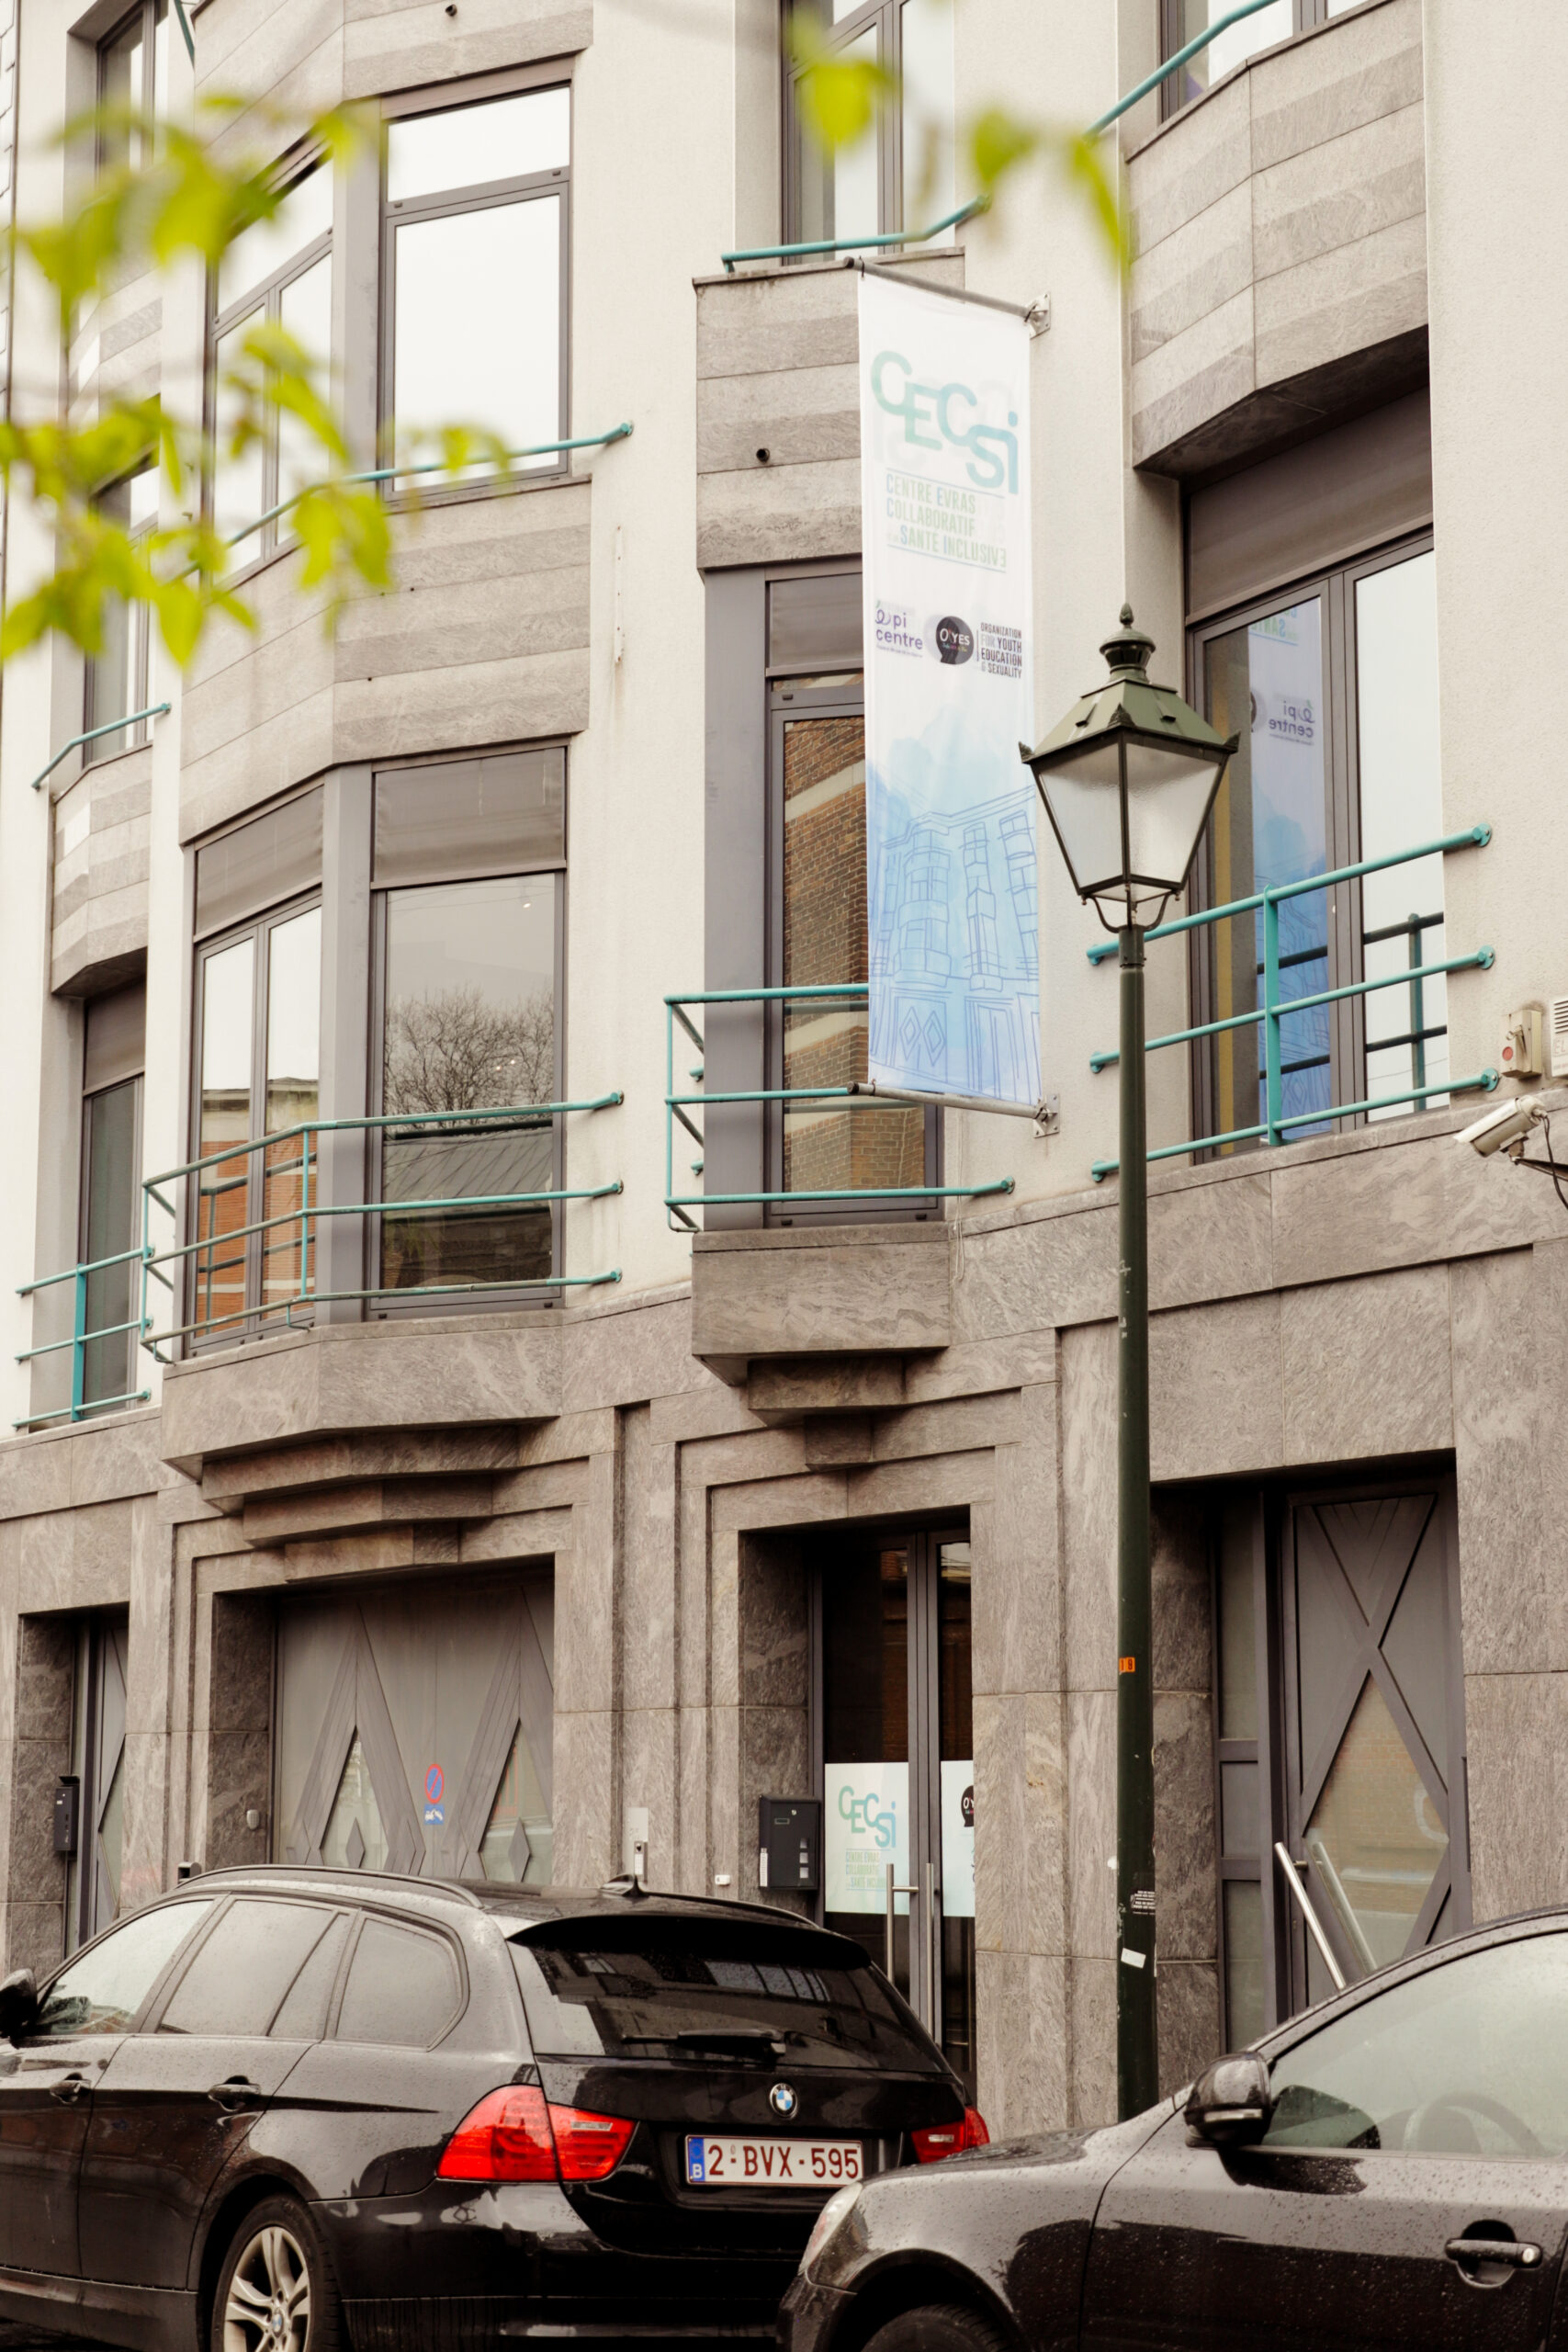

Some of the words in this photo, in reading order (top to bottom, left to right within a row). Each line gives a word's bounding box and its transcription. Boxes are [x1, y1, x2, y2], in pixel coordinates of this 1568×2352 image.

[886, 473, 932, 504] CENTRE
[937, 486, 976, 514] EVRAS
[886, 497, 976, 537] COLLABORATIF
[876, 628, 923, 650] centre
[980, 622, 1021, 639] ORGANIZATION
[997, 637, 1021, 653] YOUTH
[981, 648, 1022, 667] EDUCATION
[987, 662, 1022, 679] SEXUALITY
[692, 2163, 703, 2178] B
